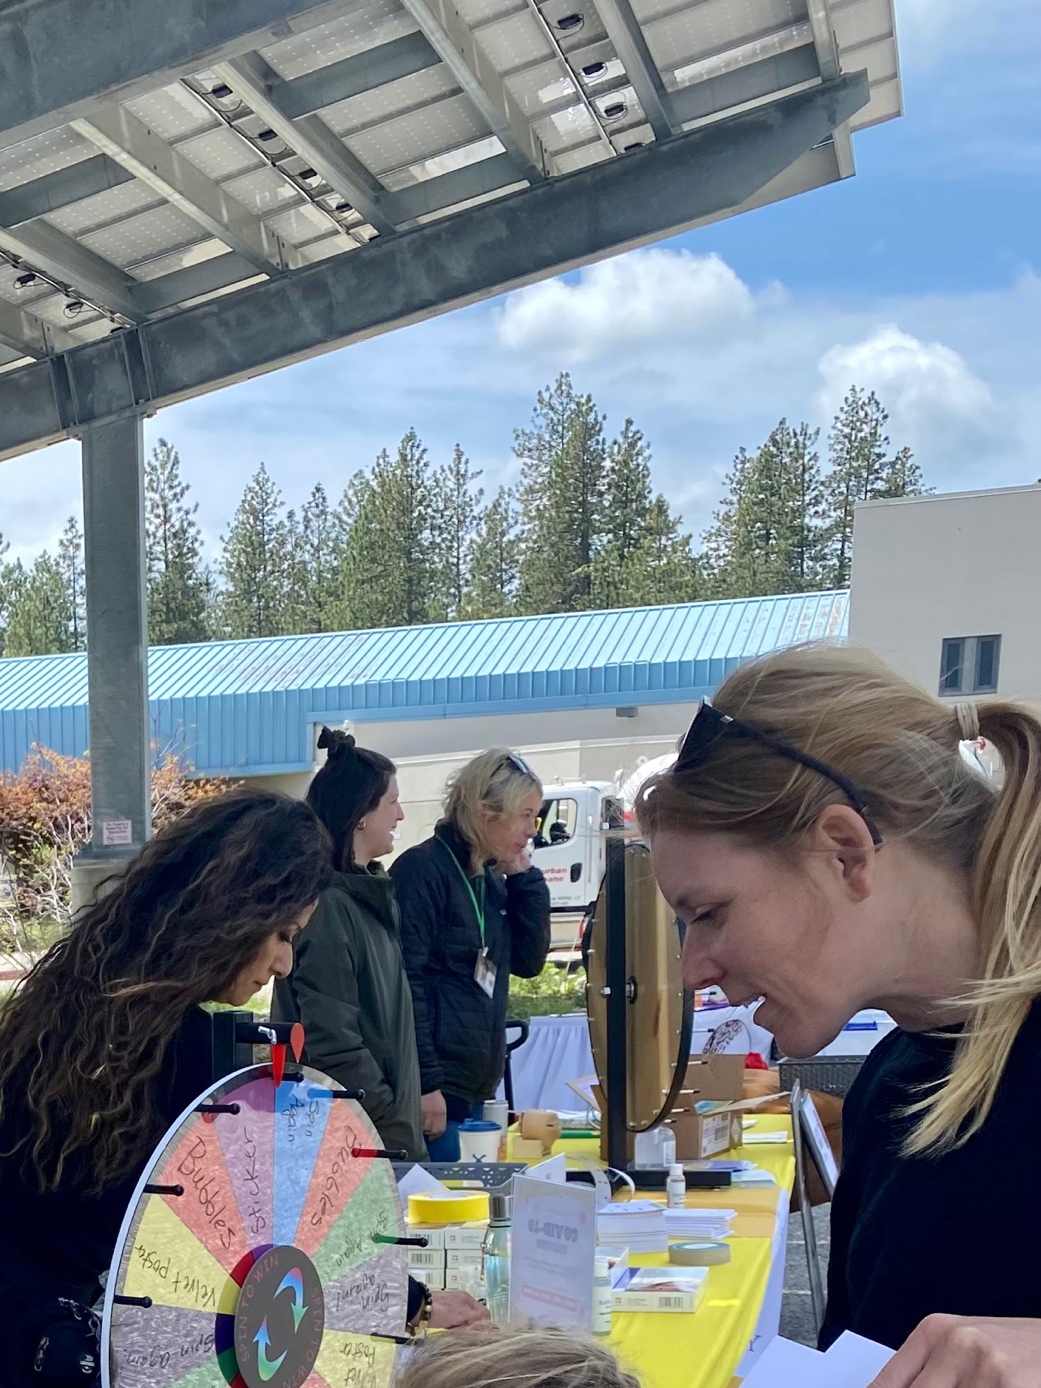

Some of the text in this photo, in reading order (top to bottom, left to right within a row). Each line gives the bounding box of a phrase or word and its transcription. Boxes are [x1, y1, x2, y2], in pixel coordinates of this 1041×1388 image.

[178, 1136, 237, 1250] Bubbles
[243, 1127, 265, 1234] Sticker
[239, 1254, 279, 1362] SPIN TO WIN
[307, 1340, 319, 1362] TO
[311, 1287, 321, 1332] SPIN
